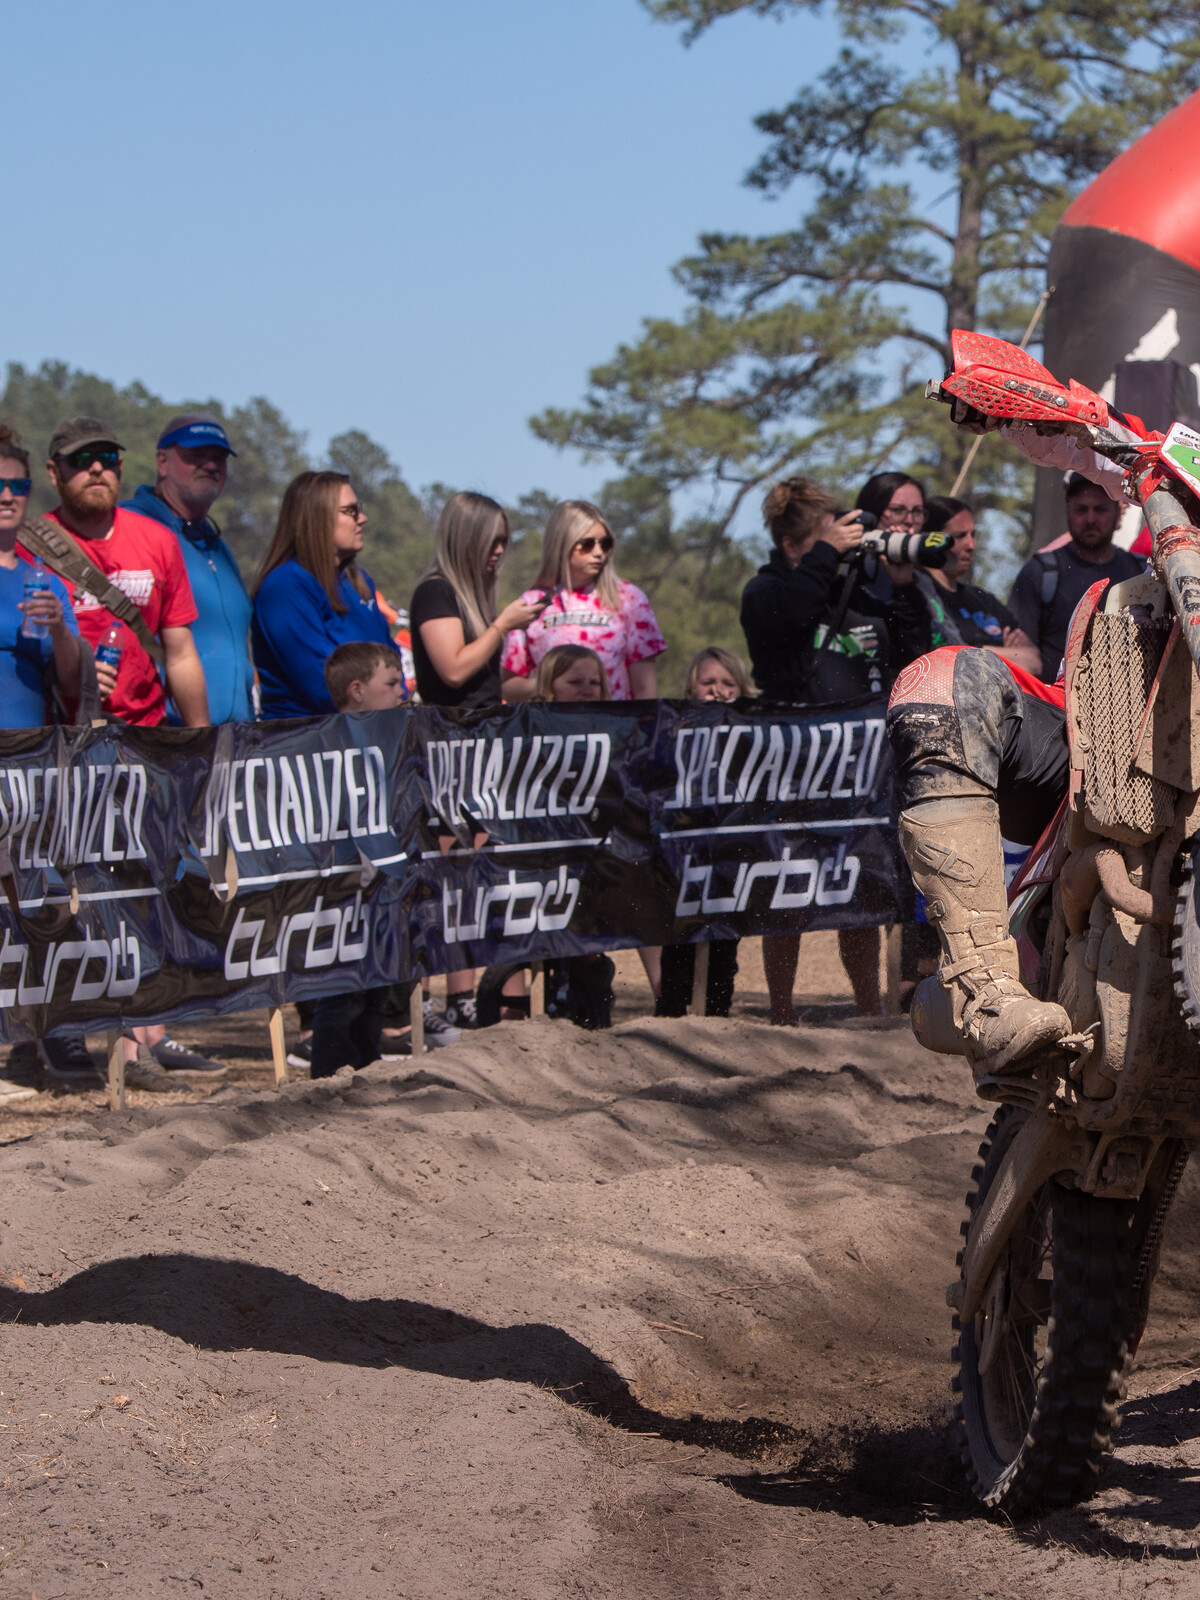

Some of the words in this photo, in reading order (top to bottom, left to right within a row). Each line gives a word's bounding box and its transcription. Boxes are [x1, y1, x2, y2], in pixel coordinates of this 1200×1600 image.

[200, 745, 389, 858] SPECIALIZED
[426, 732, 612, 826] SPECIALIZED
[663, 718, 886, 810] SPECIALIZED
[443, 864, 580, 943] turbo
[675, 843, 861, 918] turbo
[224, 888, 369, 982] turbo
